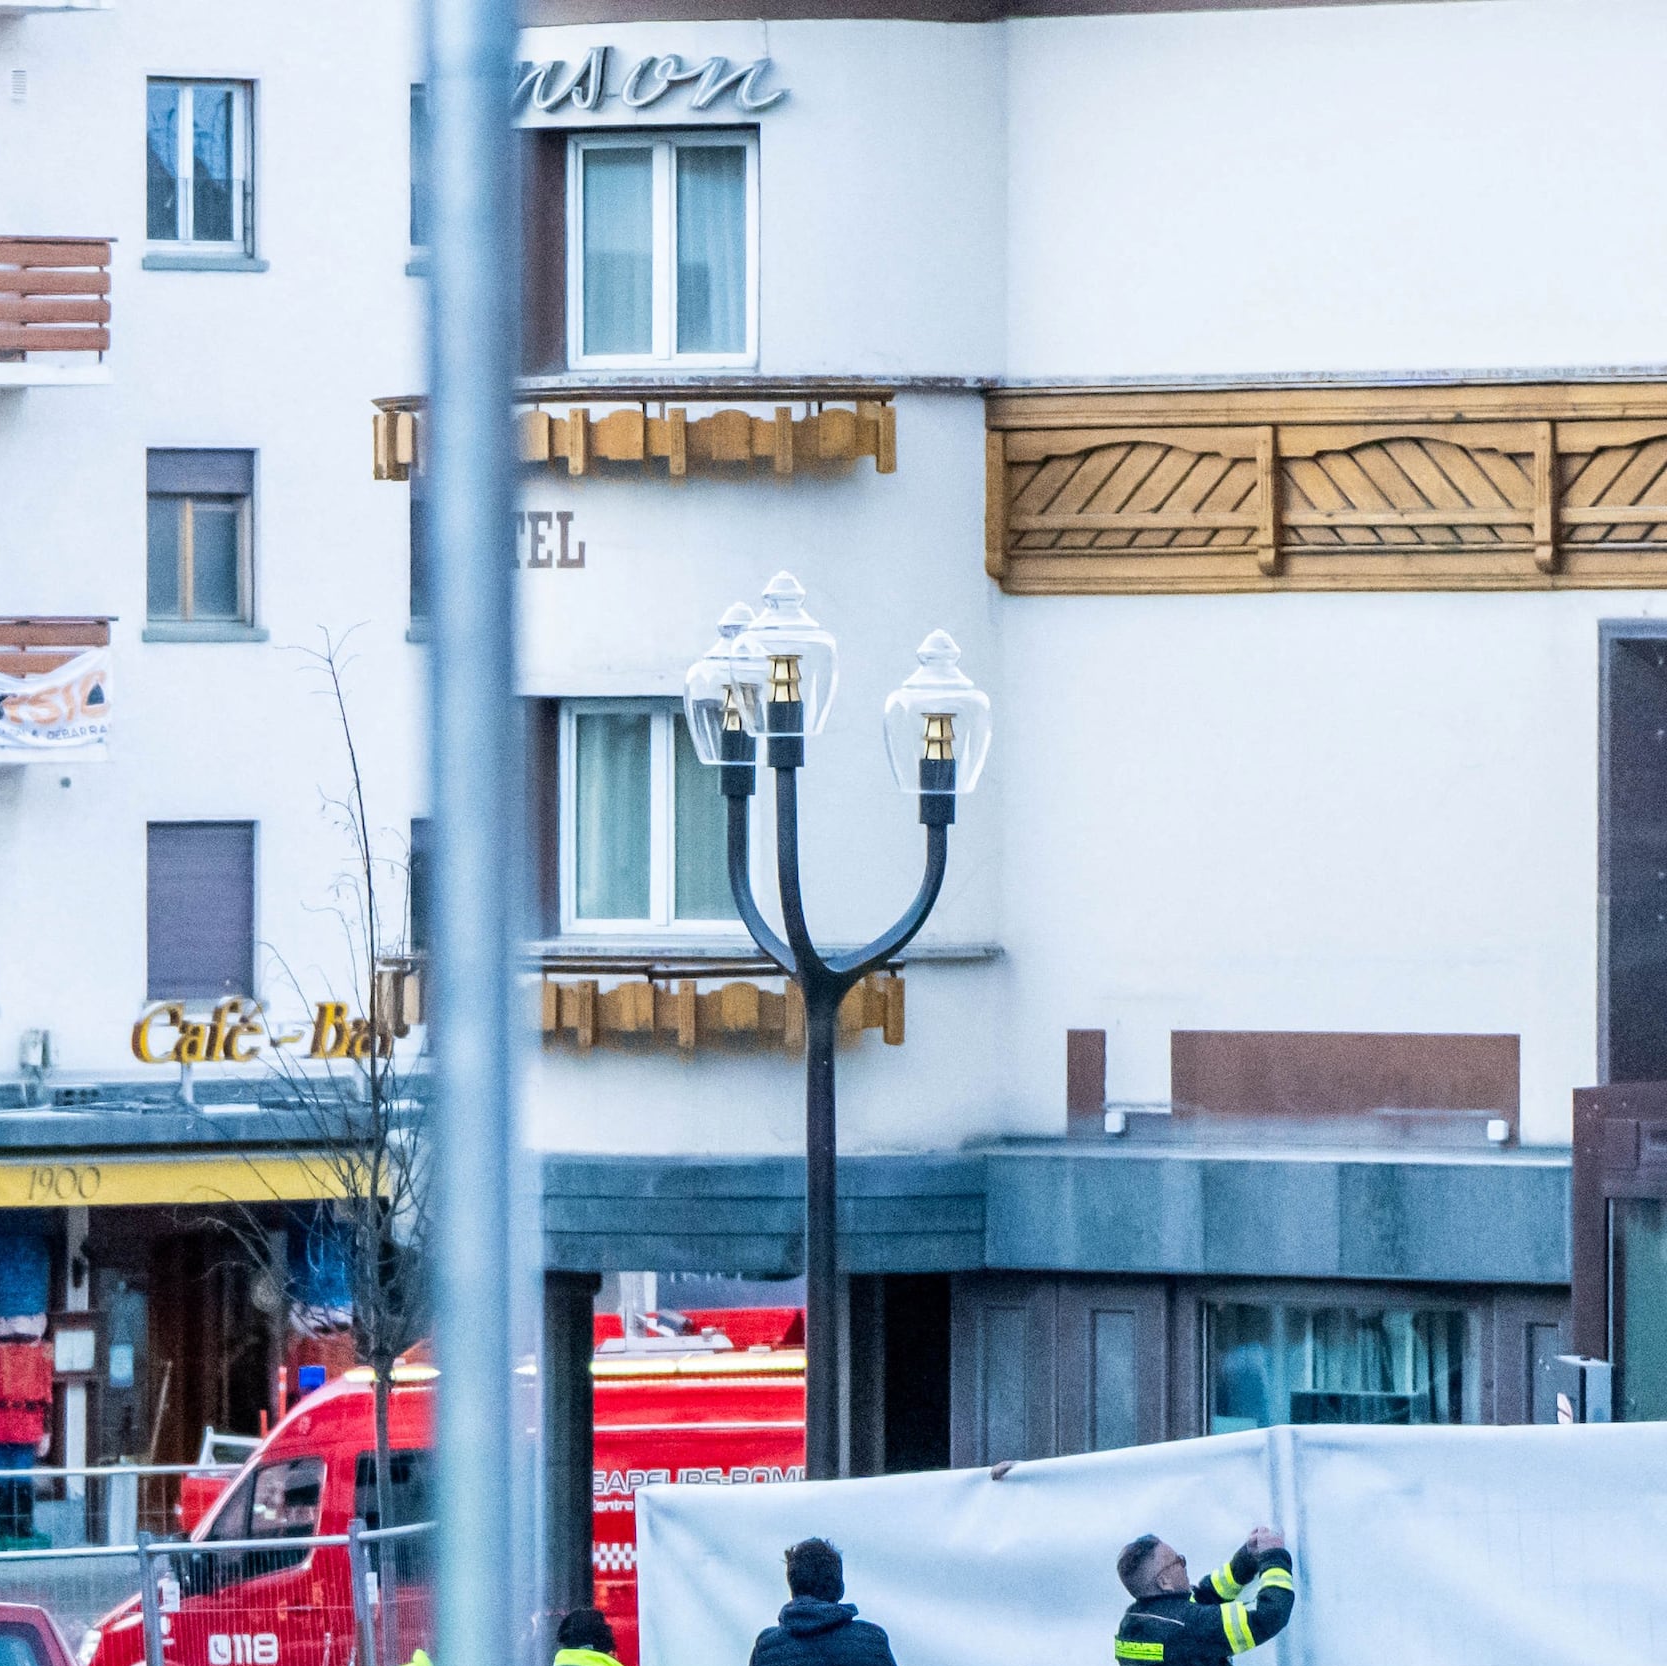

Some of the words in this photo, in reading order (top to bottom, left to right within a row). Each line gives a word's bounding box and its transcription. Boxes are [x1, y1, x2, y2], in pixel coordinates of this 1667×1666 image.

[131, 996, 264, 1063] Café
[27, 1166, 102, 1201] 1900
[593, 1466, 806, 1496] SAPEURS-POM
[231, 1632, 279, 1666] 118
